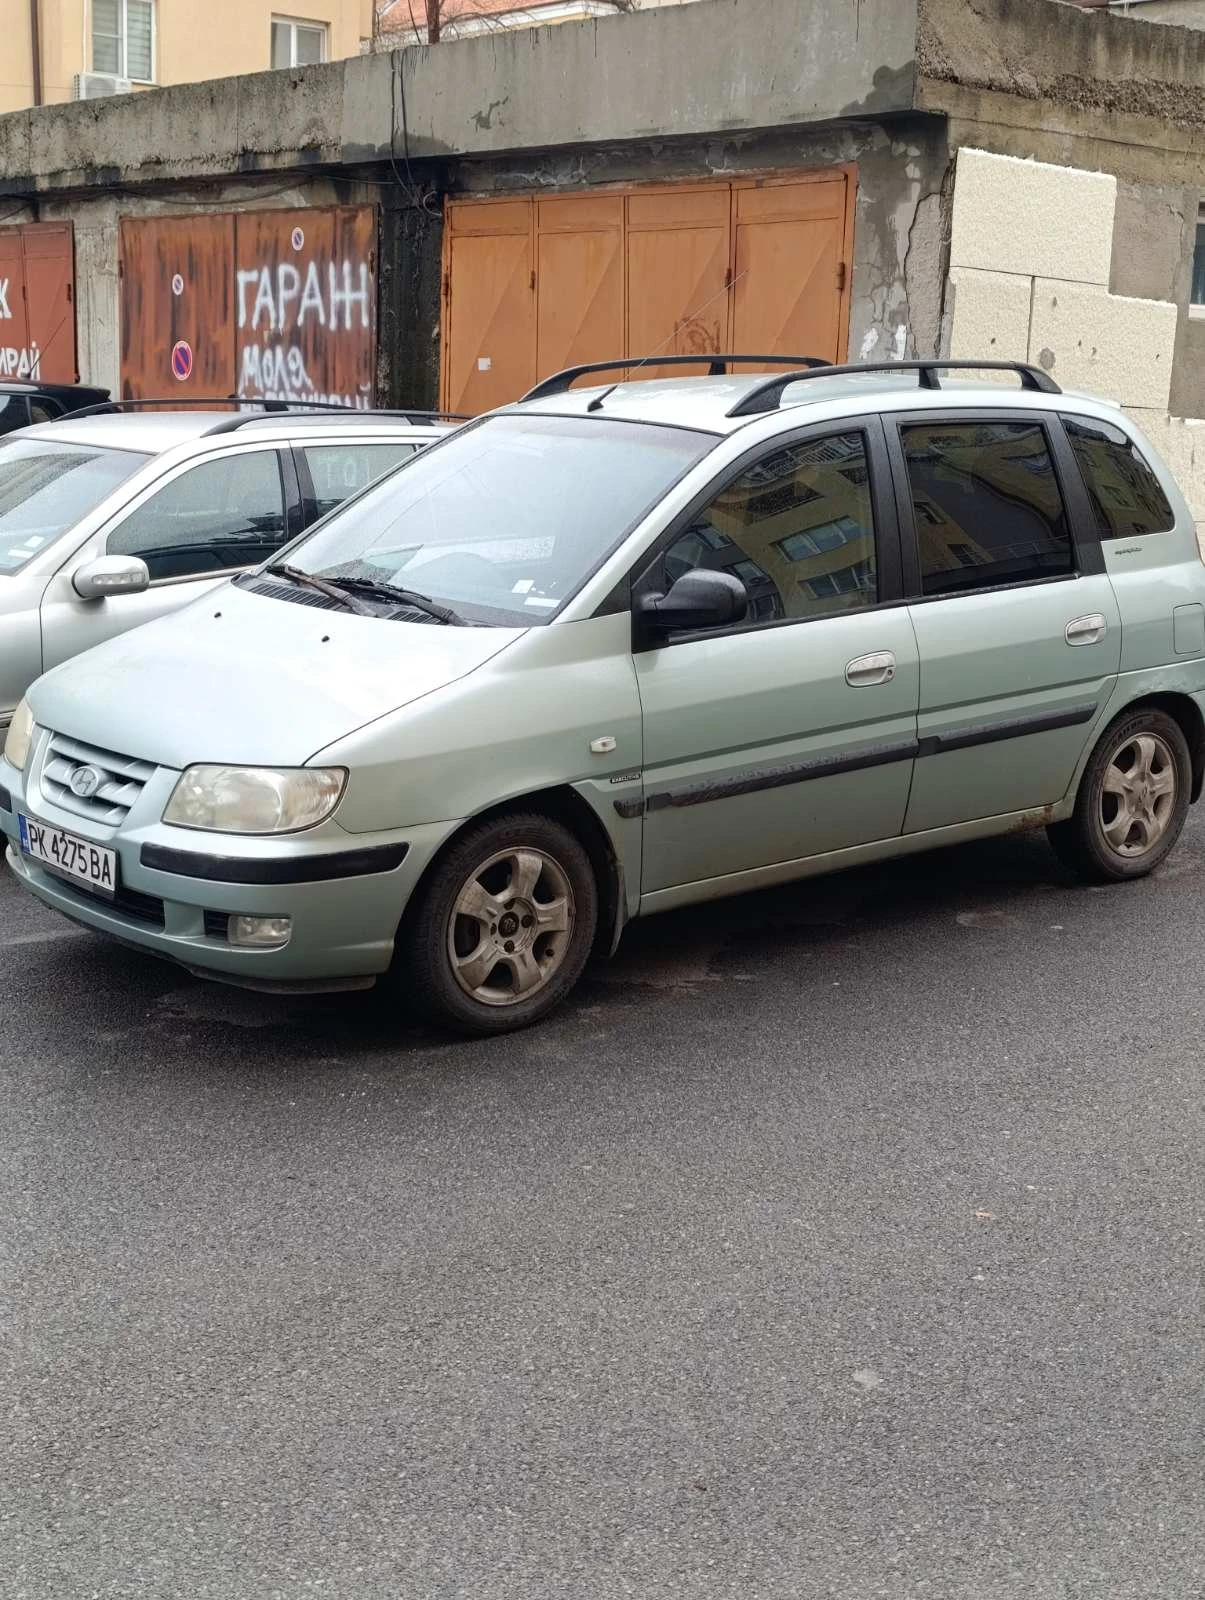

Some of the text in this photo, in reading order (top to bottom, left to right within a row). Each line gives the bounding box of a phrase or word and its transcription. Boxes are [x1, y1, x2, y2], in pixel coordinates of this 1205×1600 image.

[236, 258, 370, 333] ГАРАЖ
[28, 823, 112, 886] PK 4275 BA
